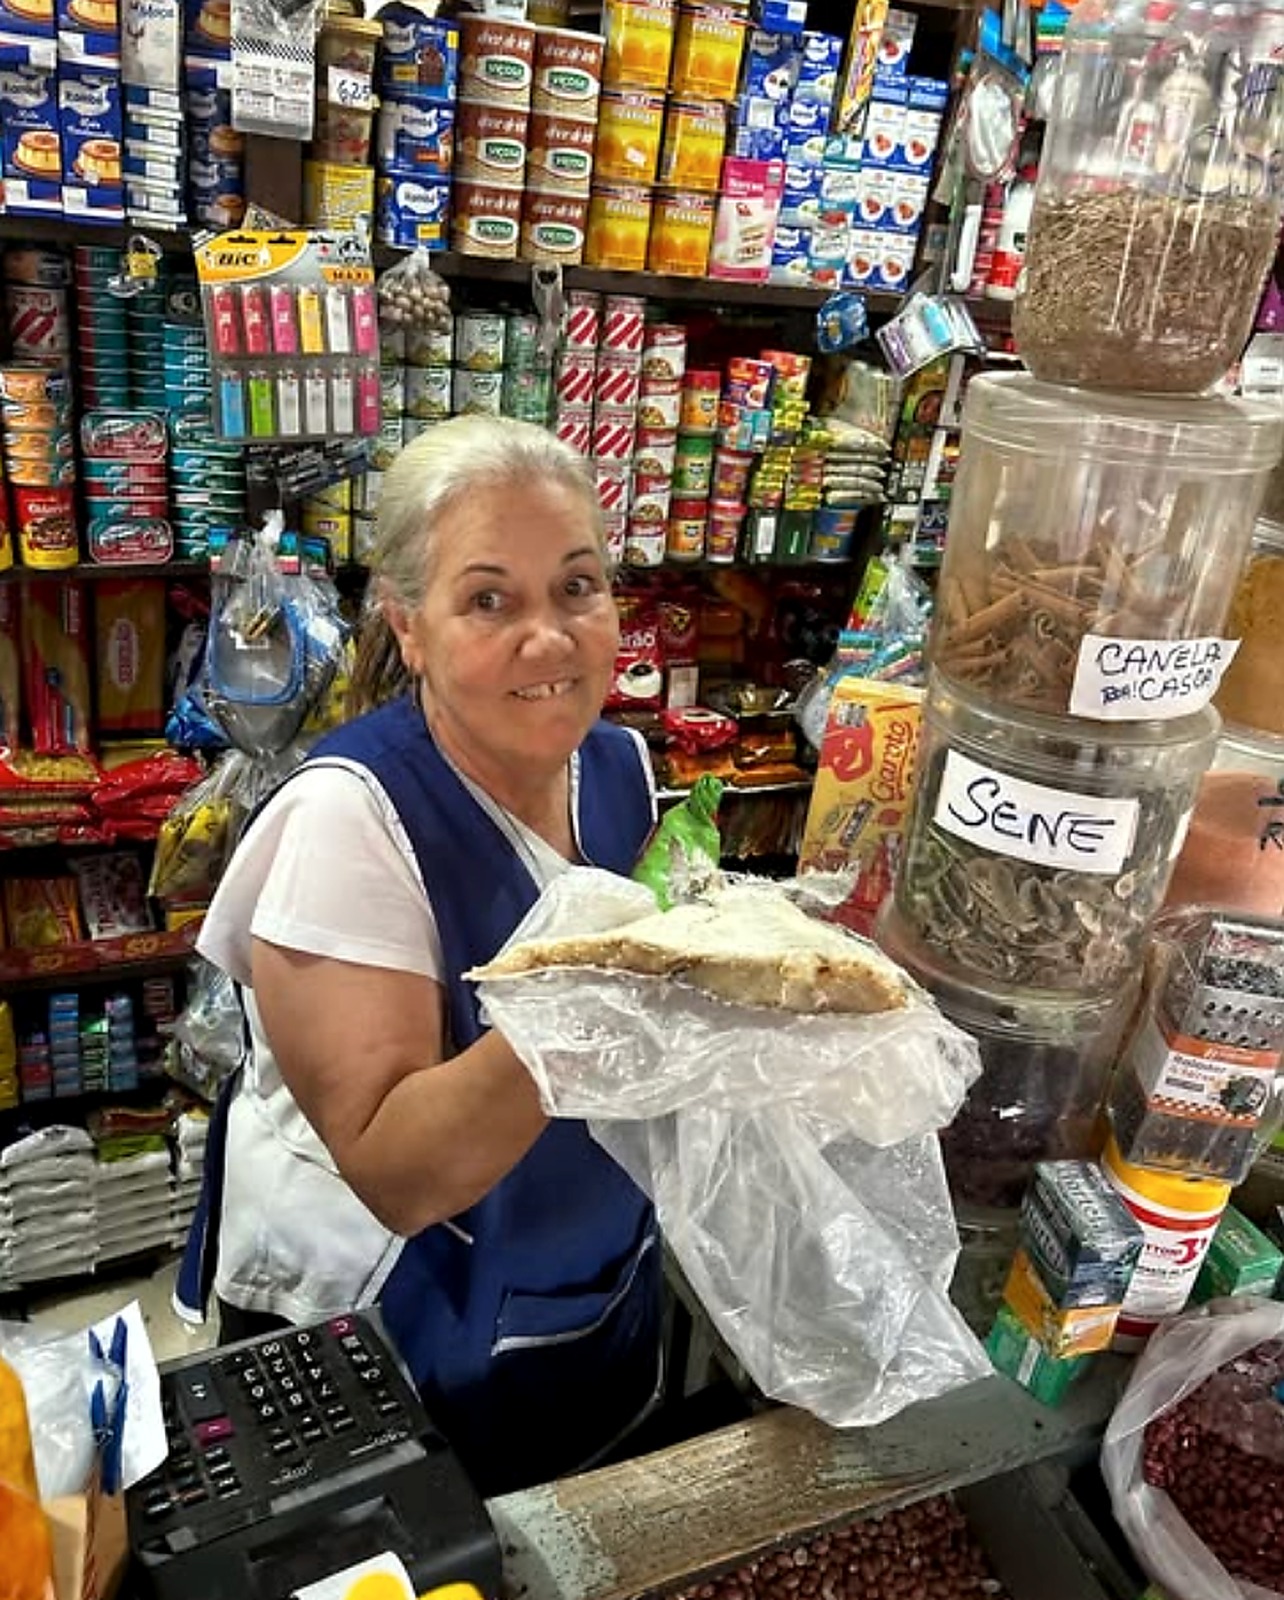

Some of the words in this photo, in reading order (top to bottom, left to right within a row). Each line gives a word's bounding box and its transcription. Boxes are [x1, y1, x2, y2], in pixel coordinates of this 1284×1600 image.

[219, 252, 257, 266] BIC
[1094, 643, 1221, 676] CANELA
[869, 721, 907, 802] Garoto
[948, 777, 1116, 853] SENE
[262, 1342, 280, 1356] 00
